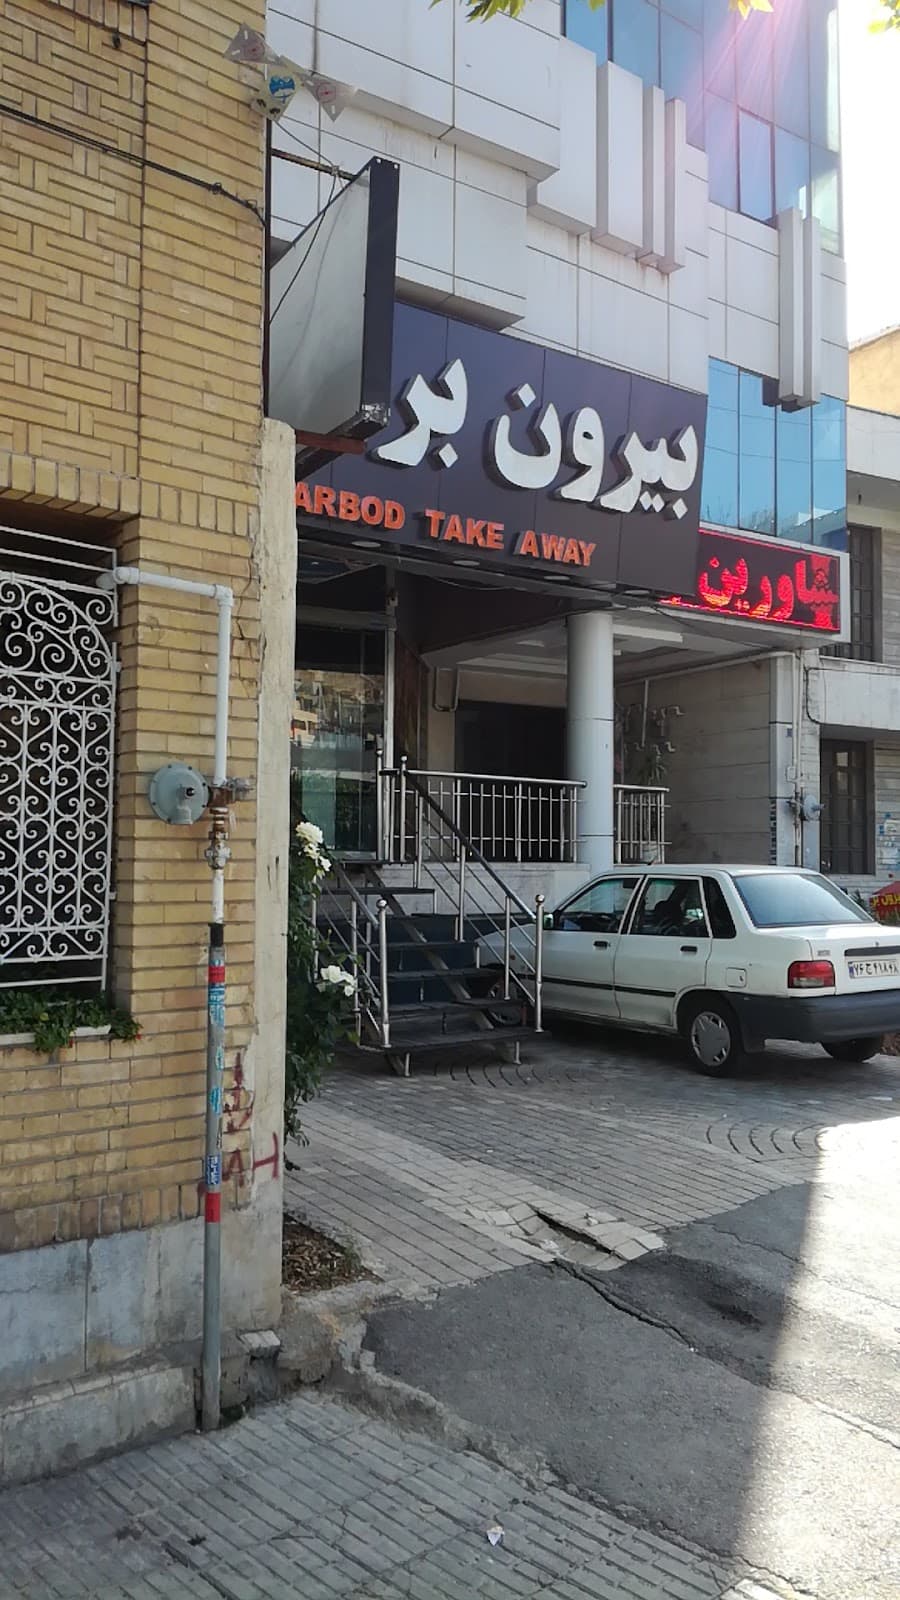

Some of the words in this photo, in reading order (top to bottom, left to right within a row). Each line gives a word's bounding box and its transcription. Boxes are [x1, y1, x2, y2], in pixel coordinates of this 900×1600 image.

[376, 358, 467, 468] بر
[491, 383, 698, 520] بیرون
[425, 508, 504, 550] TAKE
[518, 530, 597, 567] AWAY
